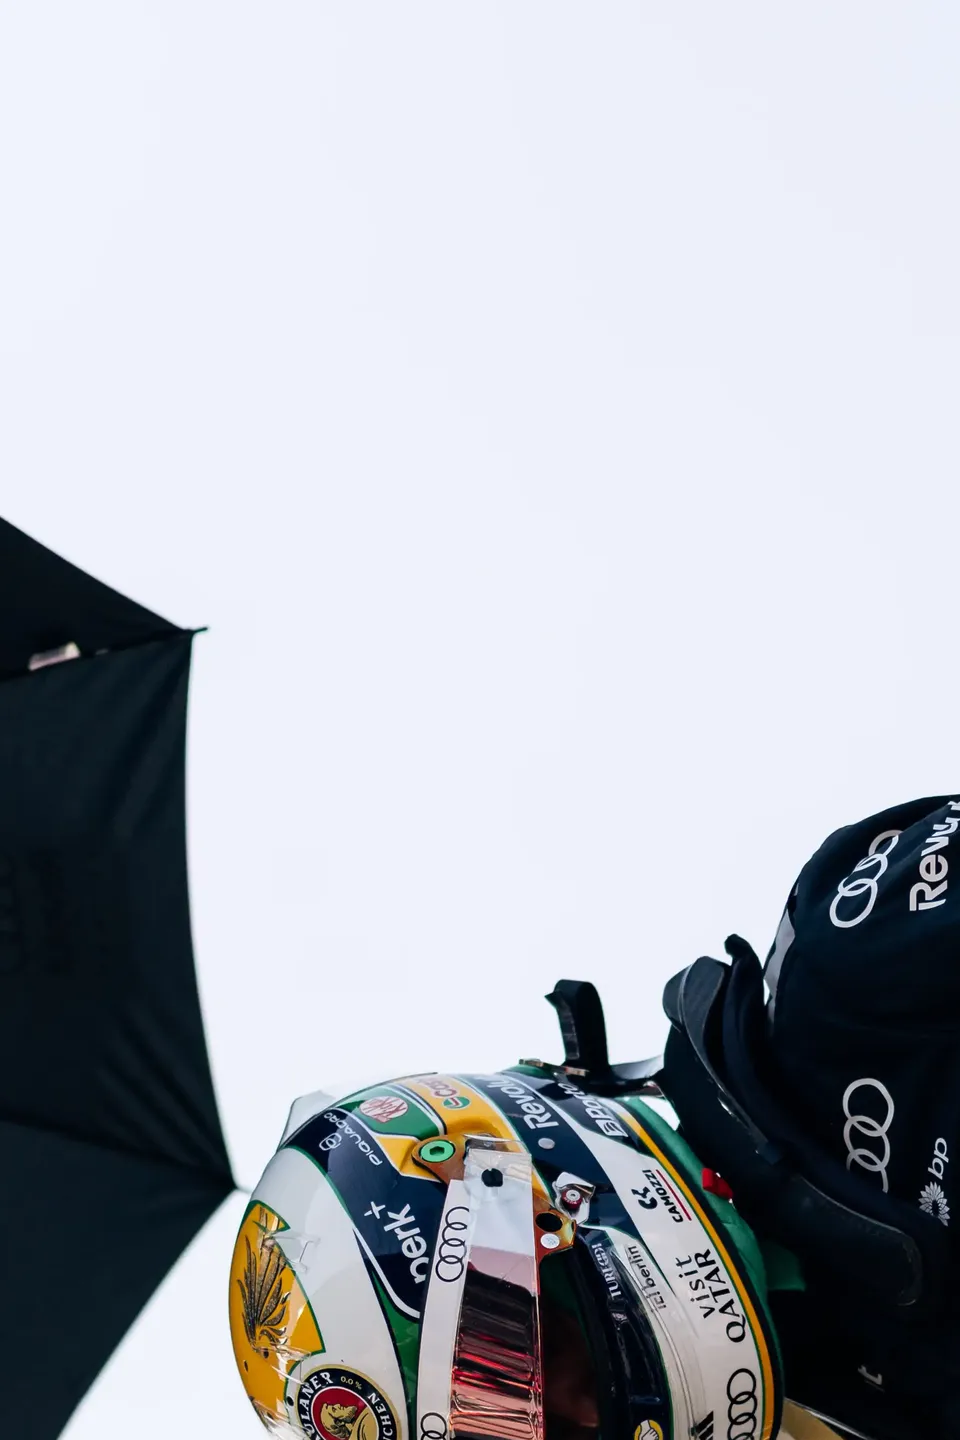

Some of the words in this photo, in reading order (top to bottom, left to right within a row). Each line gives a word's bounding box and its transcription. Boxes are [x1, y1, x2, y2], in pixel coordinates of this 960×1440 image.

[323, 1112, 383, 1166] PIQUADRO
[928, 1137, 949, 1180] bp
[642, 1169, 684, 1223] CAMOZZI
[627, 1245, 657, 1291] berlin
[675, 1254, 716, 1319] visit
[694, 1248, 747, 1343] QATAR
